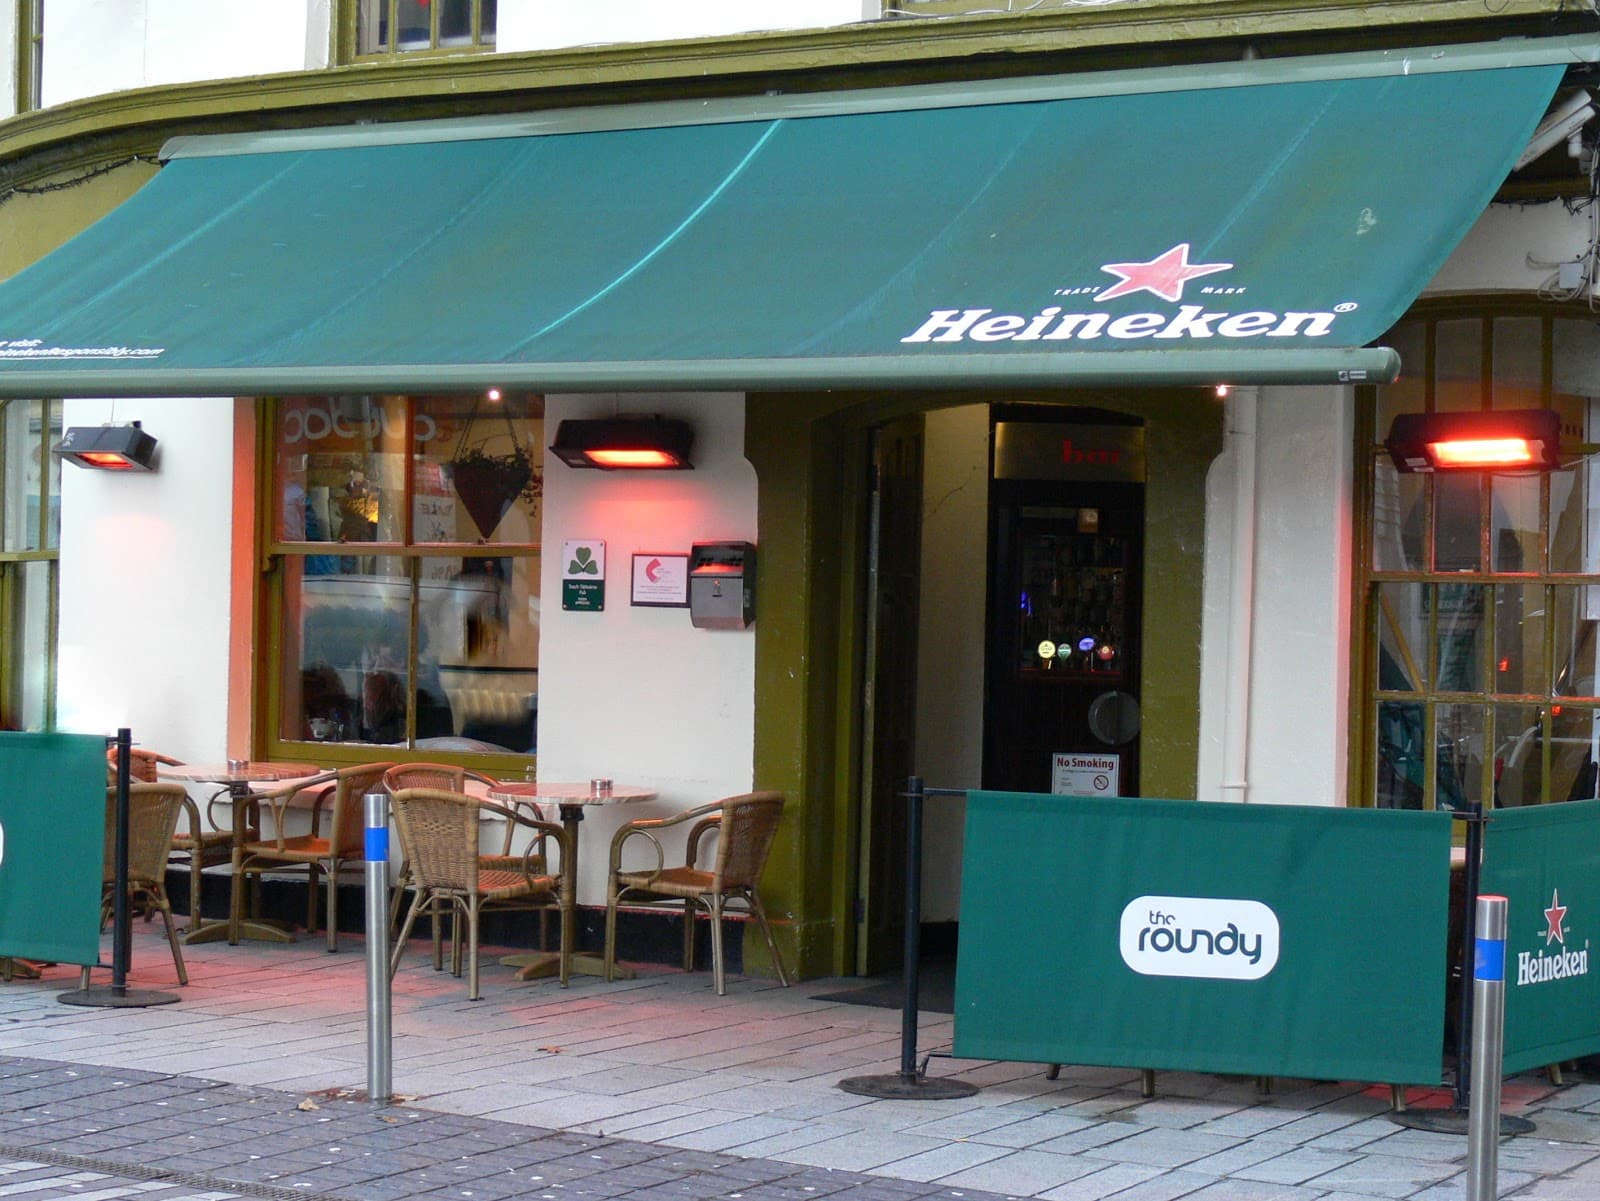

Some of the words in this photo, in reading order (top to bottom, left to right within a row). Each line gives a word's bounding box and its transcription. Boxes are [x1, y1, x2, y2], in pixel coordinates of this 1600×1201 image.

[1054, 286, 1101, 296] TRADE
[1201, 286, 1246, 295] MARK
[901, 304, 1334, 343] Heineken
[1057, 757, 1070, 767] No
[1072, 757, 1115, 771] Smoking
[1149, 910, 1176, 925] the
[1138, 922, 1262, 965] roundy
[1517, 945, 1589, 986] Heineken
